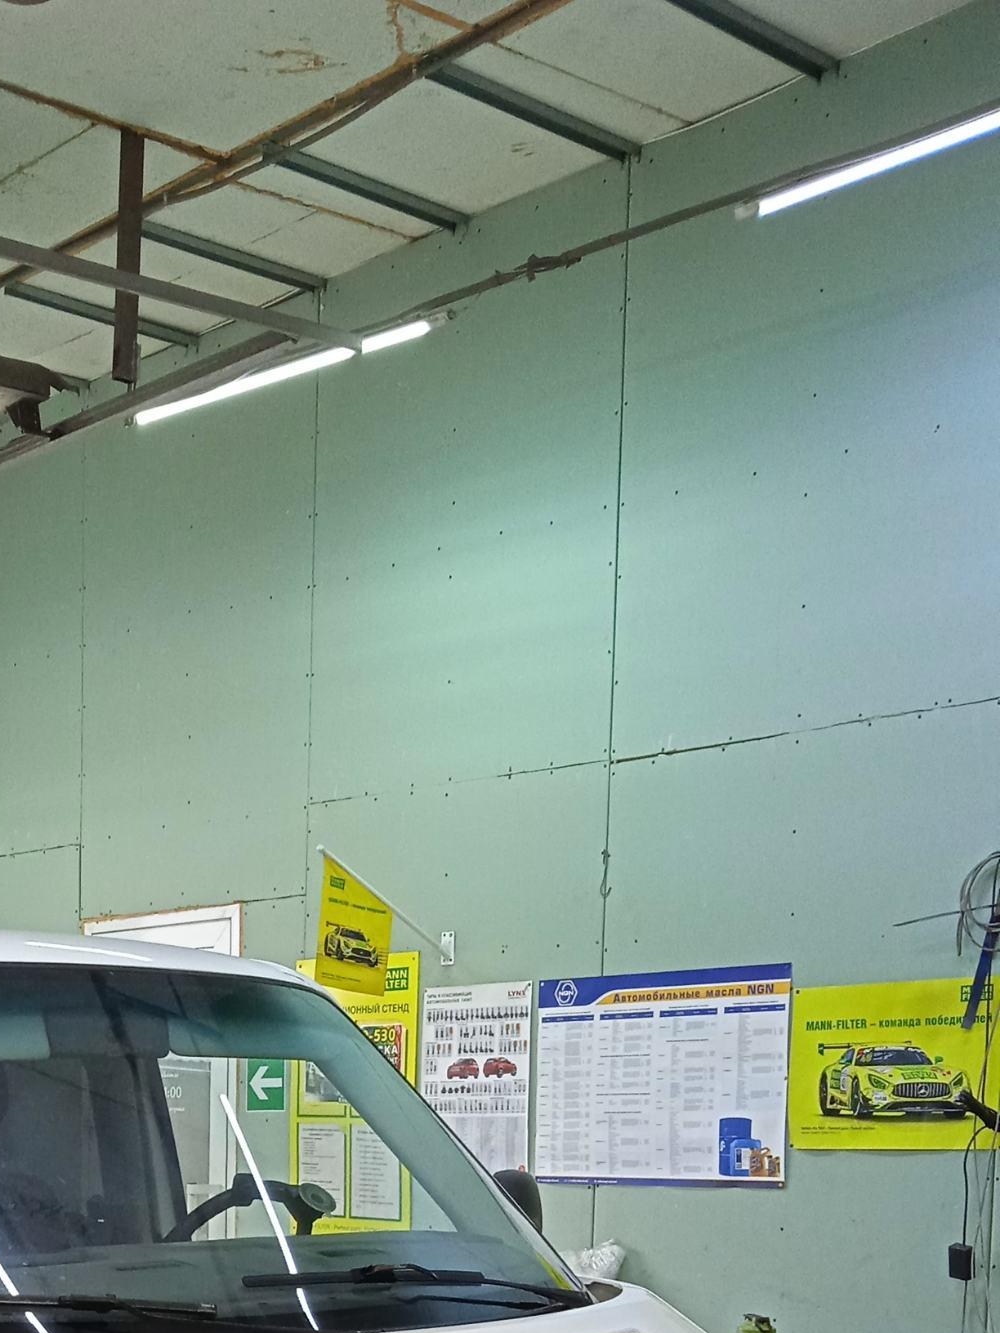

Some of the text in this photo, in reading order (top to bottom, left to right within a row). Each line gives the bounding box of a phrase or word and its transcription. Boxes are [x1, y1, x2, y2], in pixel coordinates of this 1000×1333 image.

[385, 970, 408, 979] ANN
[385, 979, 408, 989] LTER
[613, 983, 775, 1004] Автомобильные масла NGN
[343, 1003, 410, 1015] ИОННЫЙ СТЕНД
[806, 1018, 867, 1031] MANN-FILTER
[878, 1018, 921, 1029] команда
